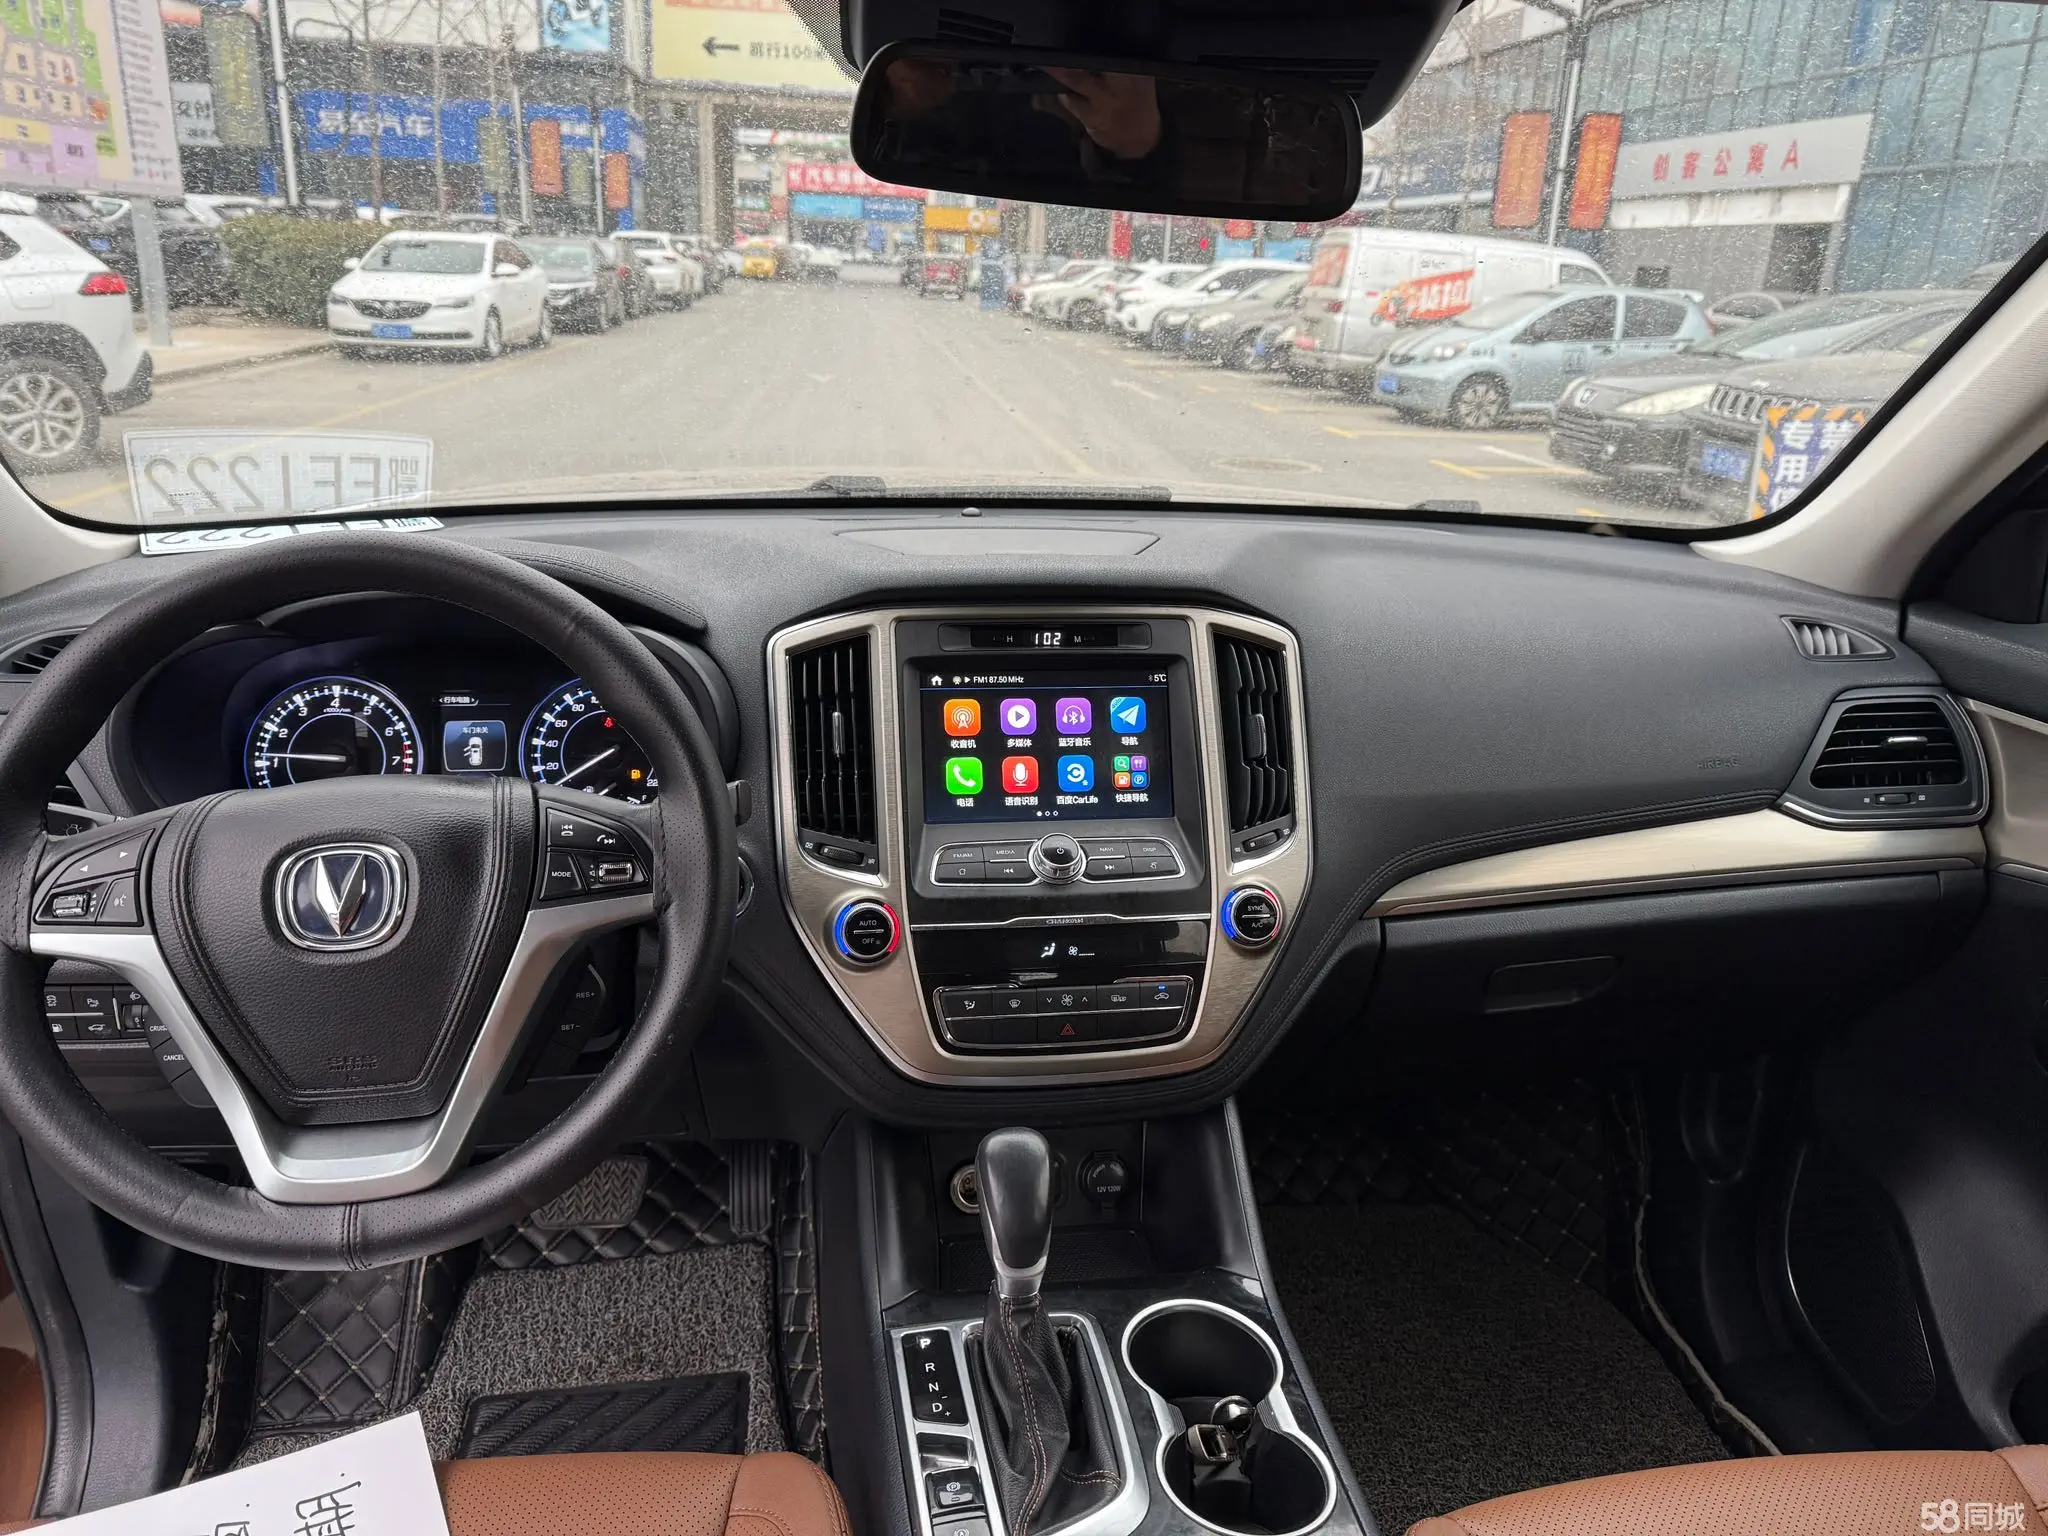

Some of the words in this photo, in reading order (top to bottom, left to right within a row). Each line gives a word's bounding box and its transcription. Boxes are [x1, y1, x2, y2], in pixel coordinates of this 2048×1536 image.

[989, 676, 1007, 684] 87.50
[1008, 676, 1024, 684] MHz
[330, 698, 340, 708] 4
[571, 703, 585, 712] 80
[298, 707, 308, 716] 3
[363, 706, 372, 715] 5
[554, 720, 568, 728] 60
[278, 728, 289, 738] 2
[384, 727, 394, 736] 6
[950, 739, 977, 749] 收音机
[1007, 738, 1032, 748] 多媒体
[1058, 737, 1092, 747] 蓝牙音乐
[1121, 736, 1139, 746] 导航
[272, 757, 279, 768] 1
[392, 756, 401, 765] 7
[545, 762, 559, 770] 20
[956, 798, 974, 807] 电话
[1004, 796, 1038, 806] 语音识别
[1056, 795, 1099, 805] 百度CarLife
[1115, 793, 1149, 803] 快捷导航
[920, 1338, 931, 1349] P
[925, 1362, 936, 1373] R
[928, 1381, 939, 1393] N
[932, 1402, 943, 1413] D
